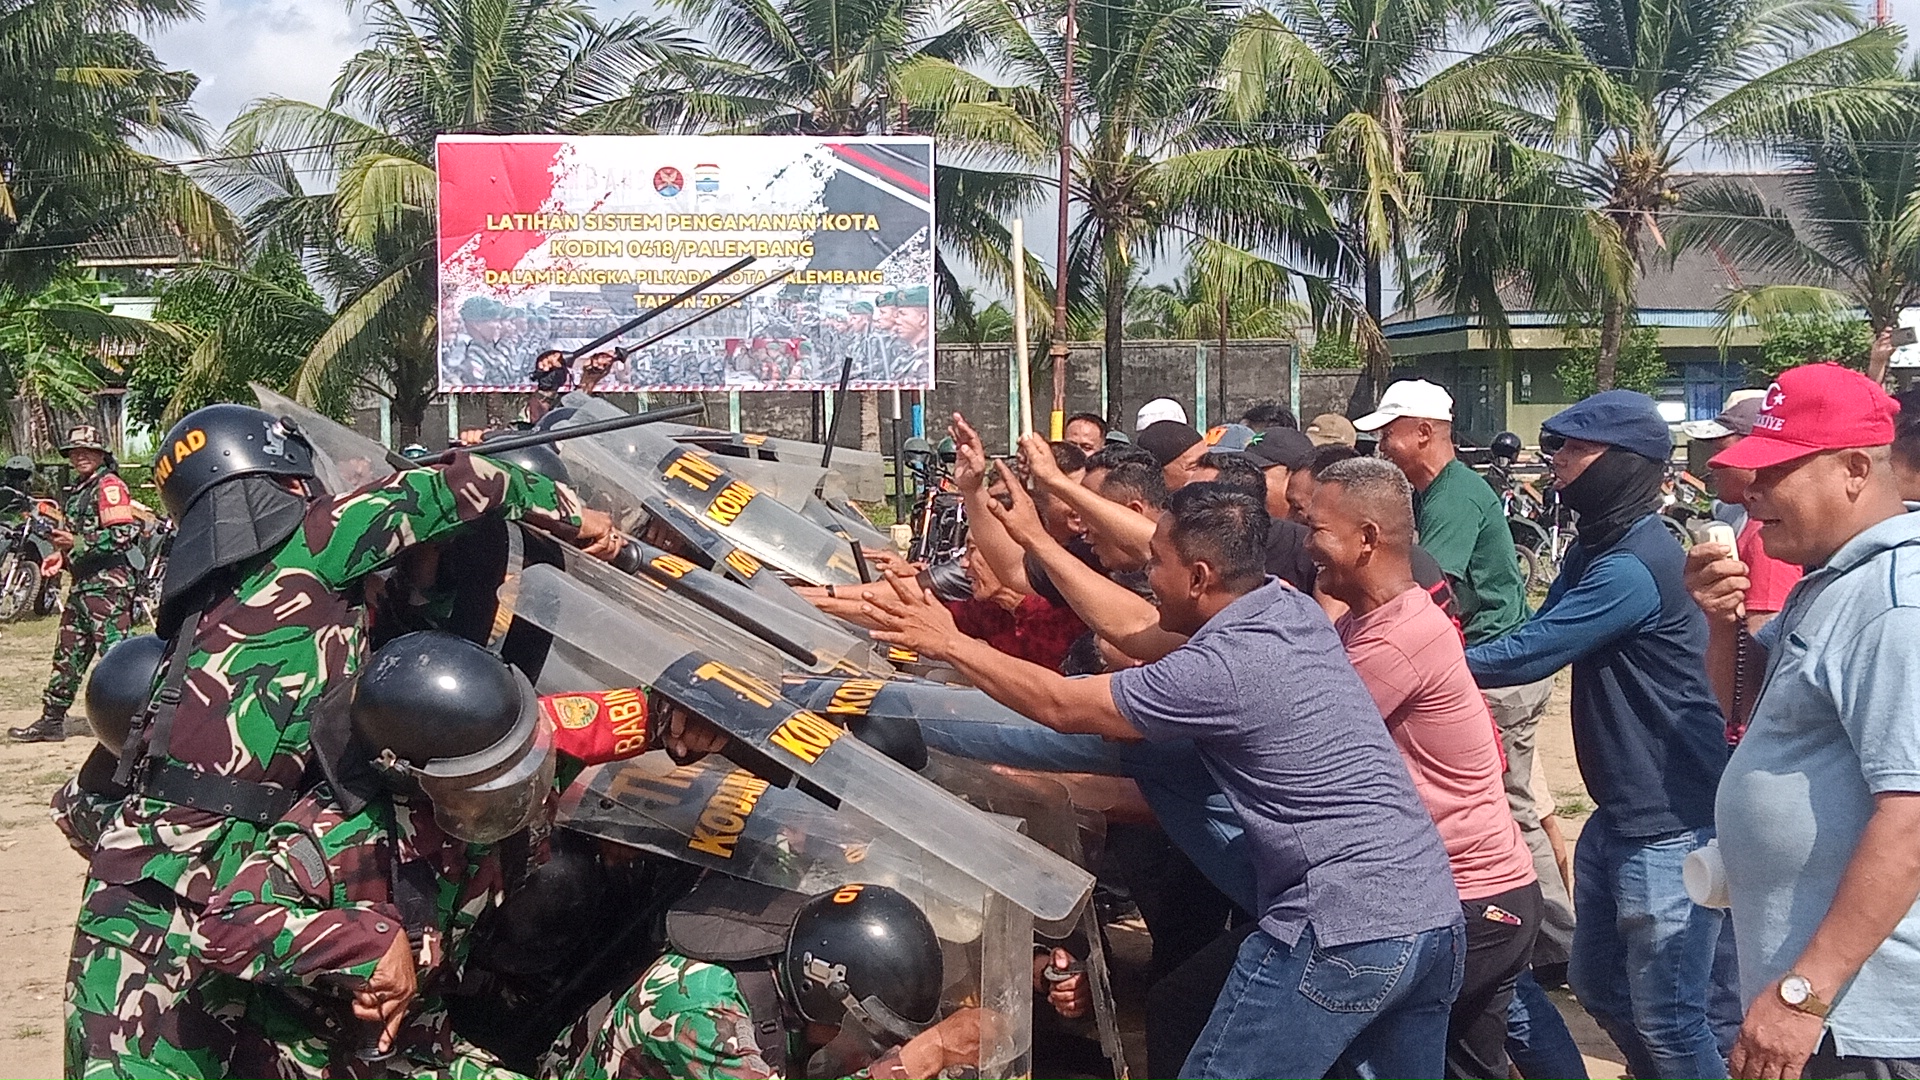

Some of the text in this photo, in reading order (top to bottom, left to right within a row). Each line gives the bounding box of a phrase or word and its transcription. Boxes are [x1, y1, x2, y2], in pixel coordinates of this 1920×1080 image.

[486, 213, 880, 231] LATIHAN SISTEM PENGAMANAN KOTA
[551, 240, 815, 264] KODIM 0418/PALEMBANG
[485, 270, 550, 285] DALAM
[555, 269, 632, 285] RANGKA
[636, 269, 712, 285] PILKADA
[174, 429, 207, 464] AD
